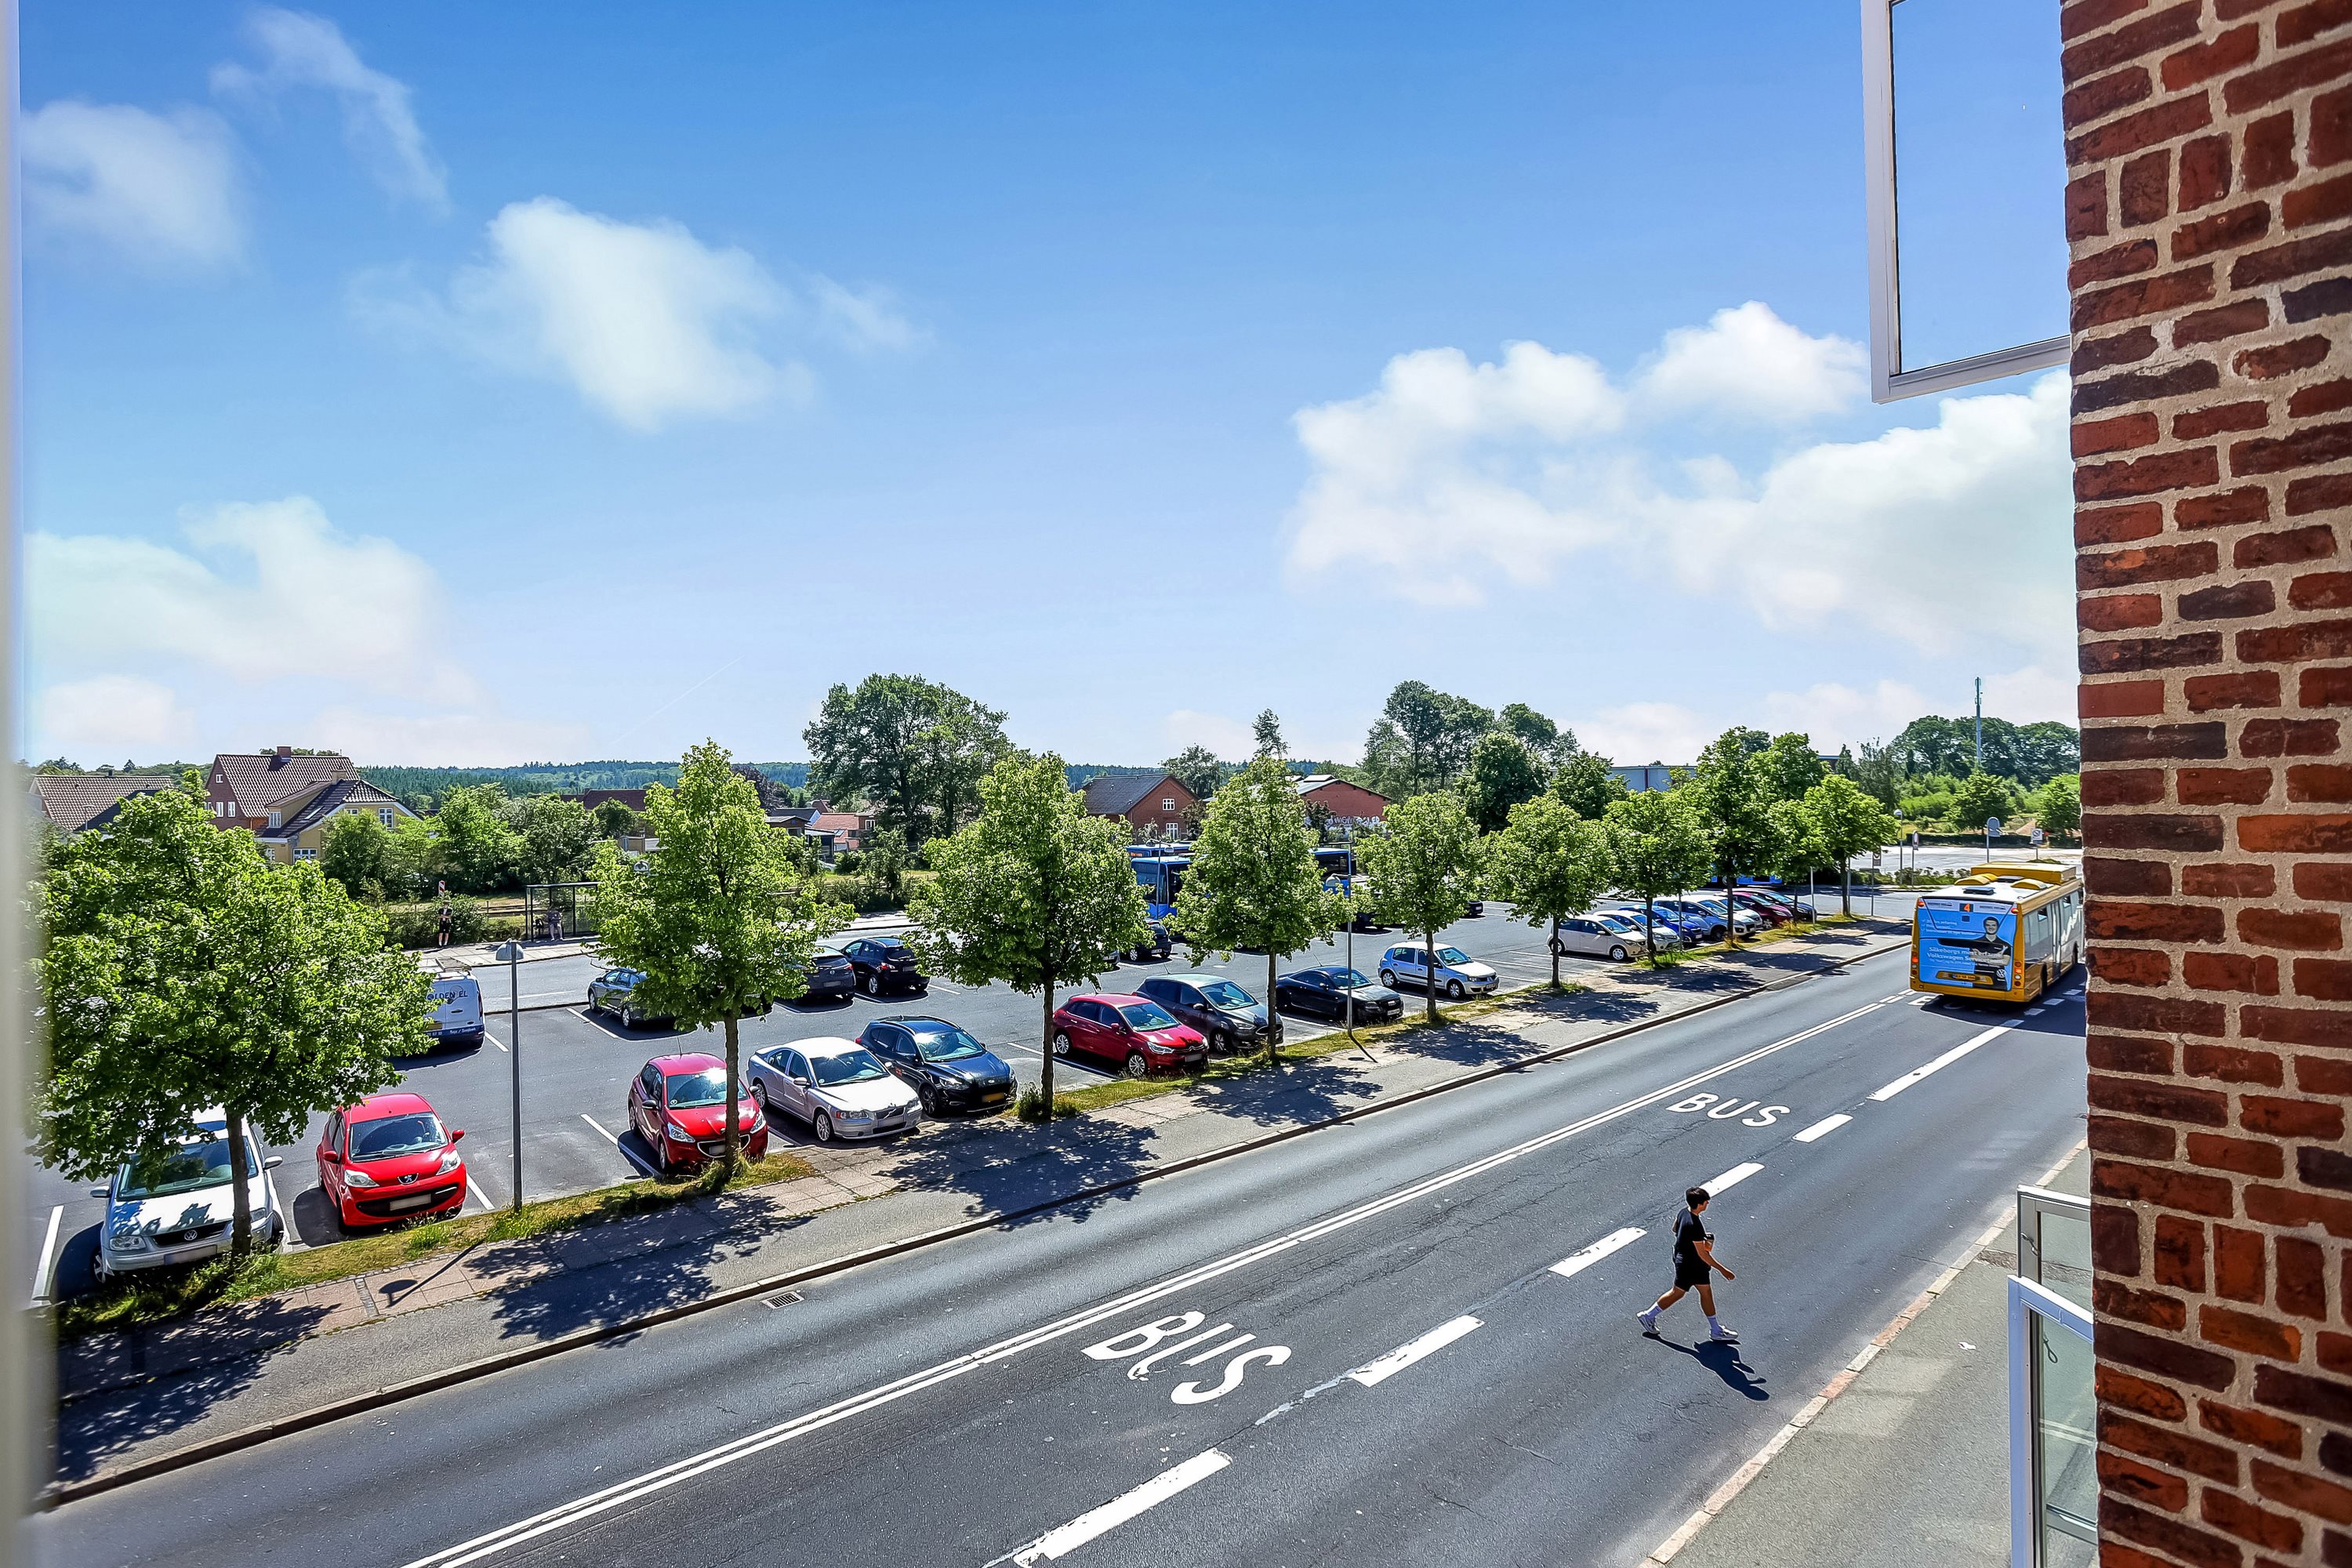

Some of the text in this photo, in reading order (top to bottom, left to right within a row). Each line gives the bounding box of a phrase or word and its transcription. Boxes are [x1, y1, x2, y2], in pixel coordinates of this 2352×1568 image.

[1964, 903, 1970, 913] 4
[1665, 1092, 1791, 1127] BUS
[1080, 1310, 1292, 1405] BUS
